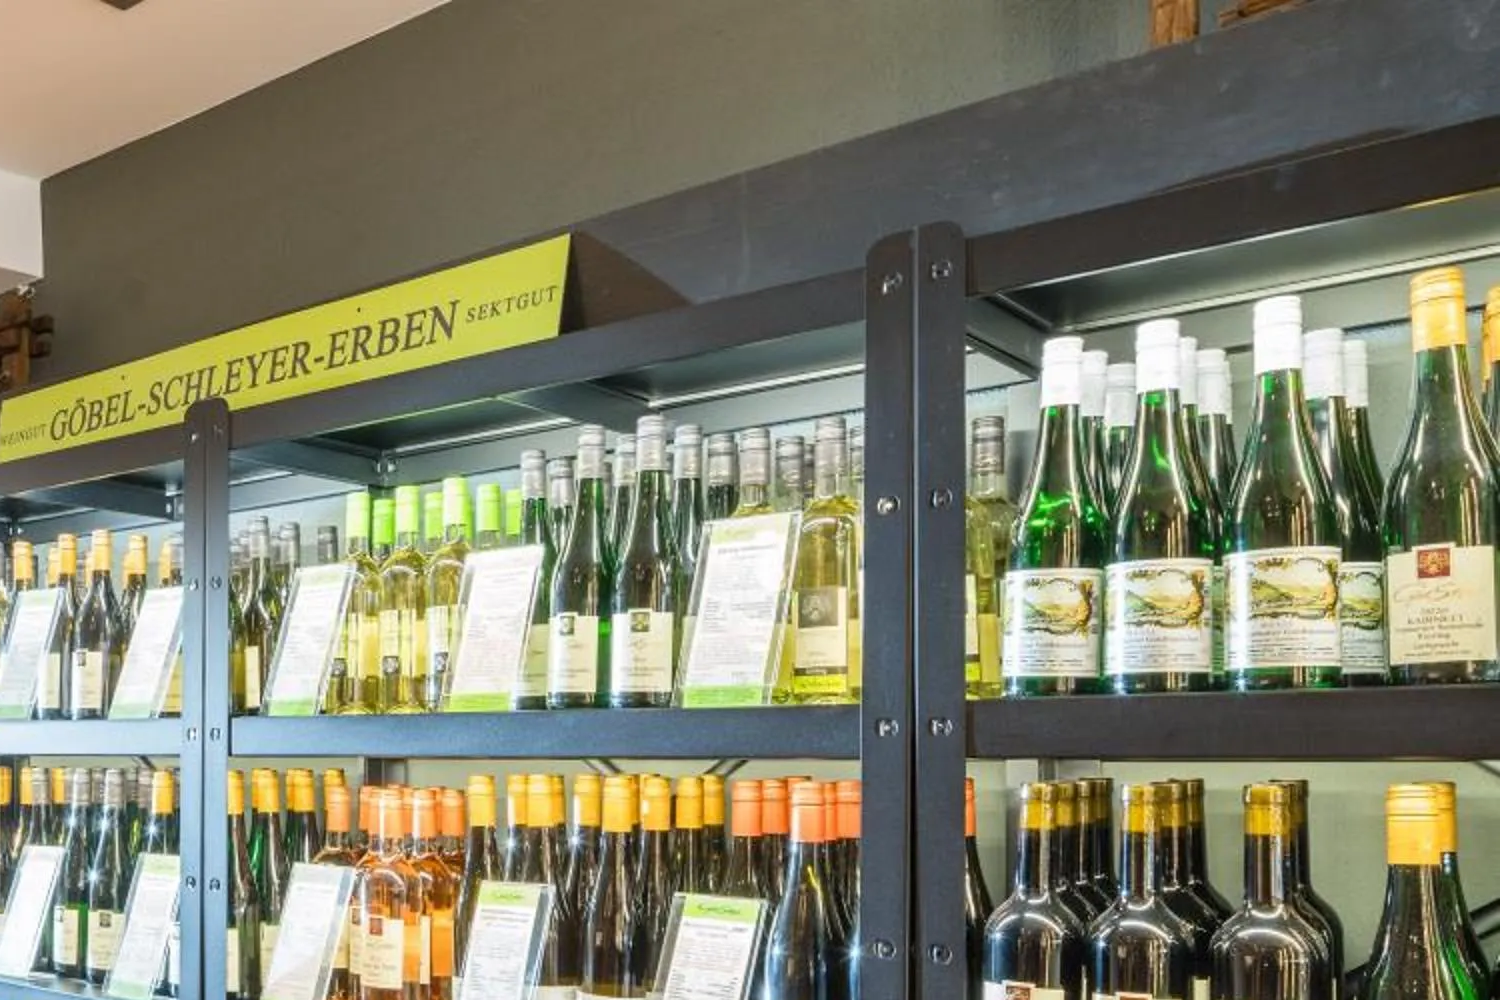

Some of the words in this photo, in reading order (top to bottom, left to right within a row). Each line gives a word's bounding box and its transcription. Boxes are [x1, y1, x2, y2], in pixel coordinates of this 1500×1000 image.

[1, 423, 47, 446] WEINGUT
[51, 299, 461, 442] GÖBEL-SCHLEYER-ERBEN
[465, 285, 559, 323] SEKTGUT
